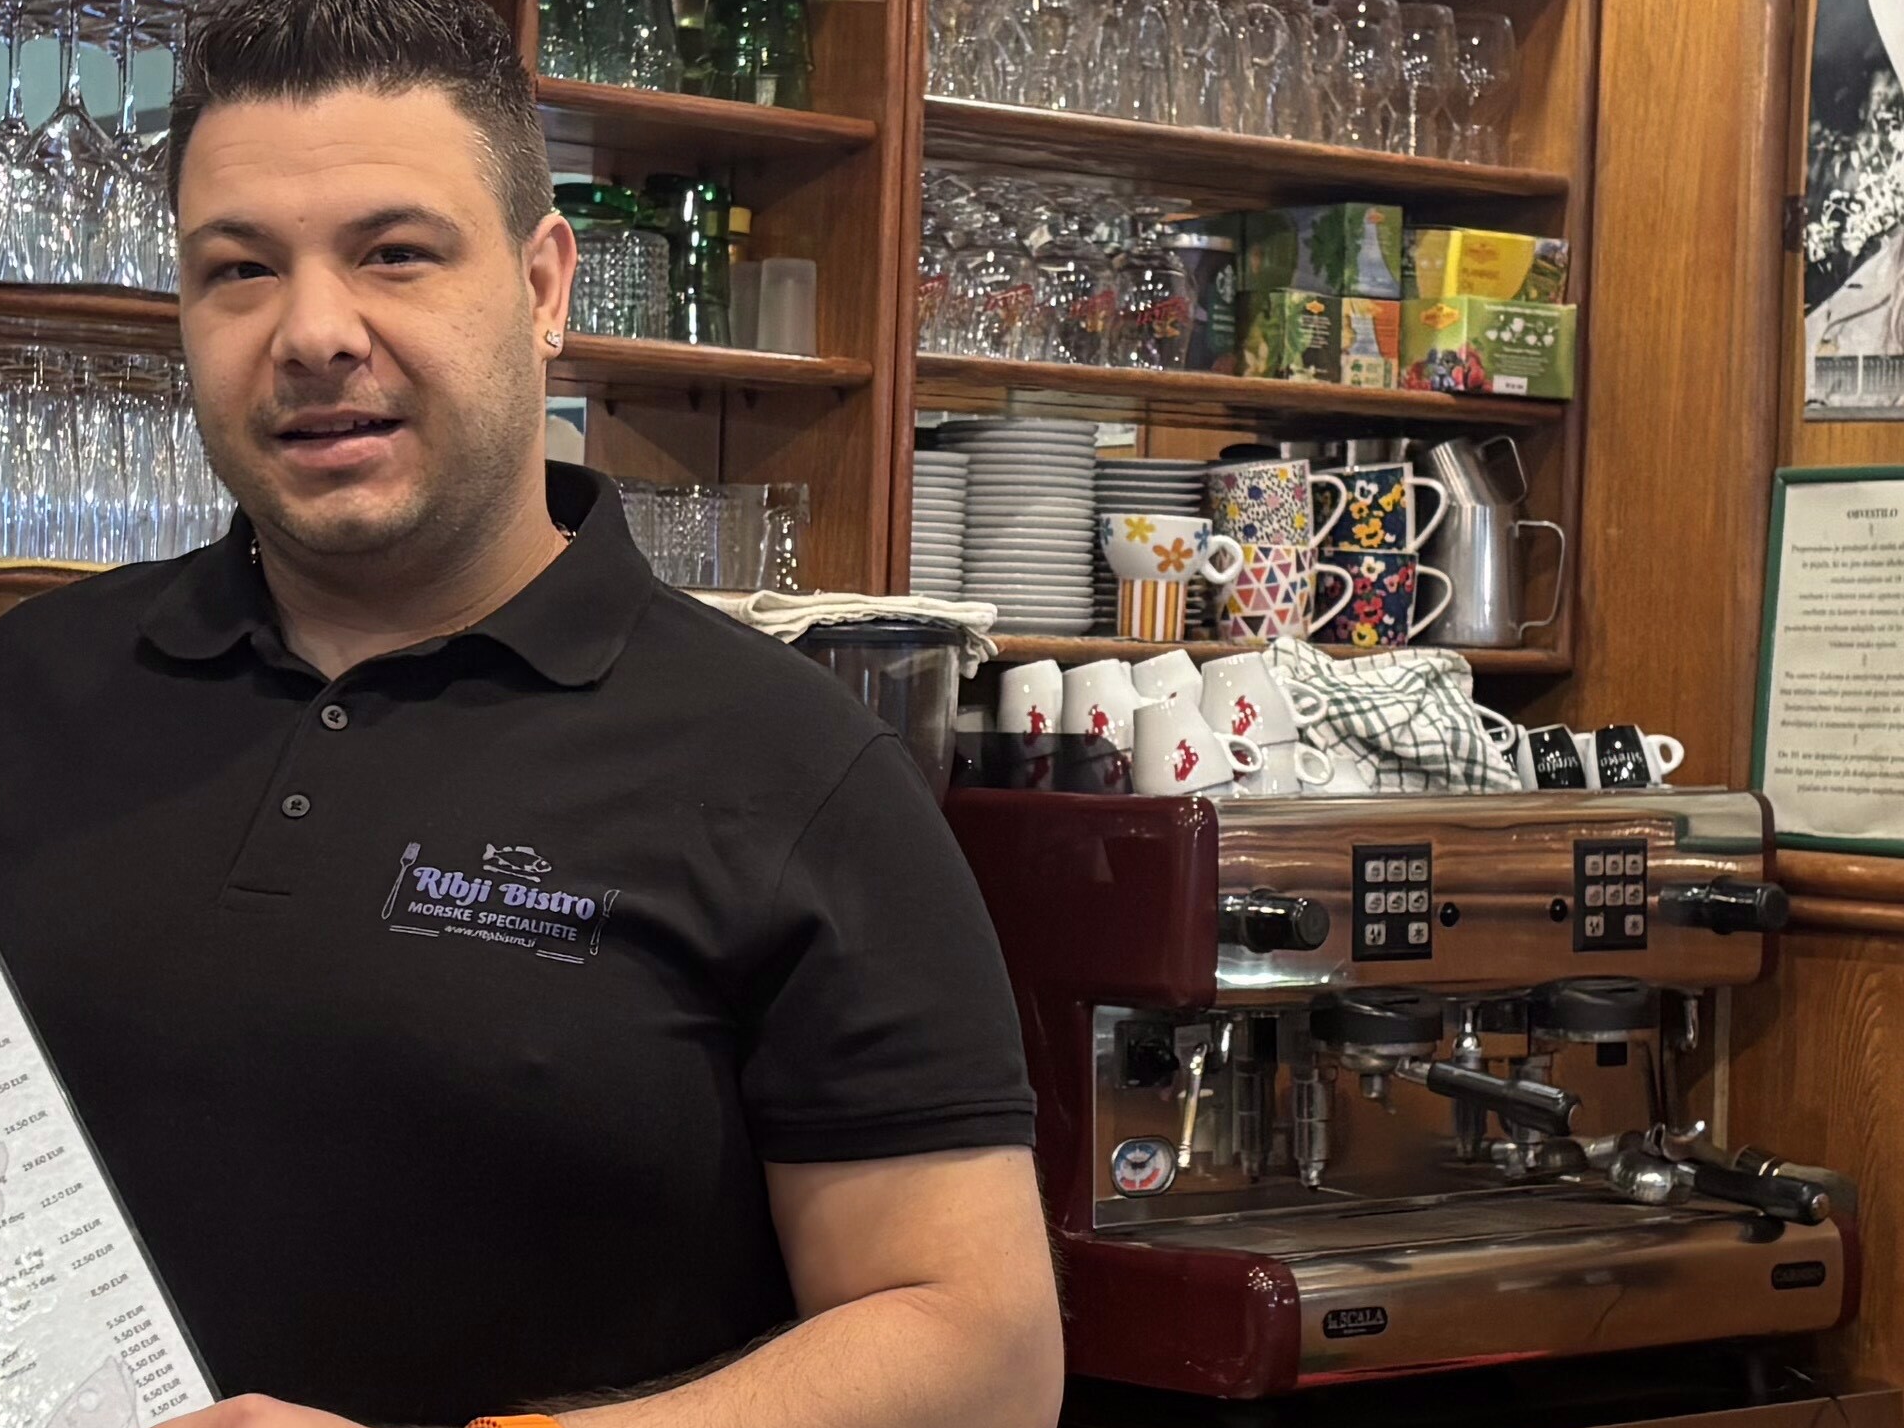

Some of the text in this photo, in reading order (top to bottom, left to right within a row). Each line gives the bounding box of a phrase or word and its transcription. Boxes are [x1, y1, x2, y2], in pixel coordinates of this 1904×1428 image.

[412, 866, 596, 921] Ribji Bistro
[407, 901, 578, 942] MORSKE SPECIALITETE
